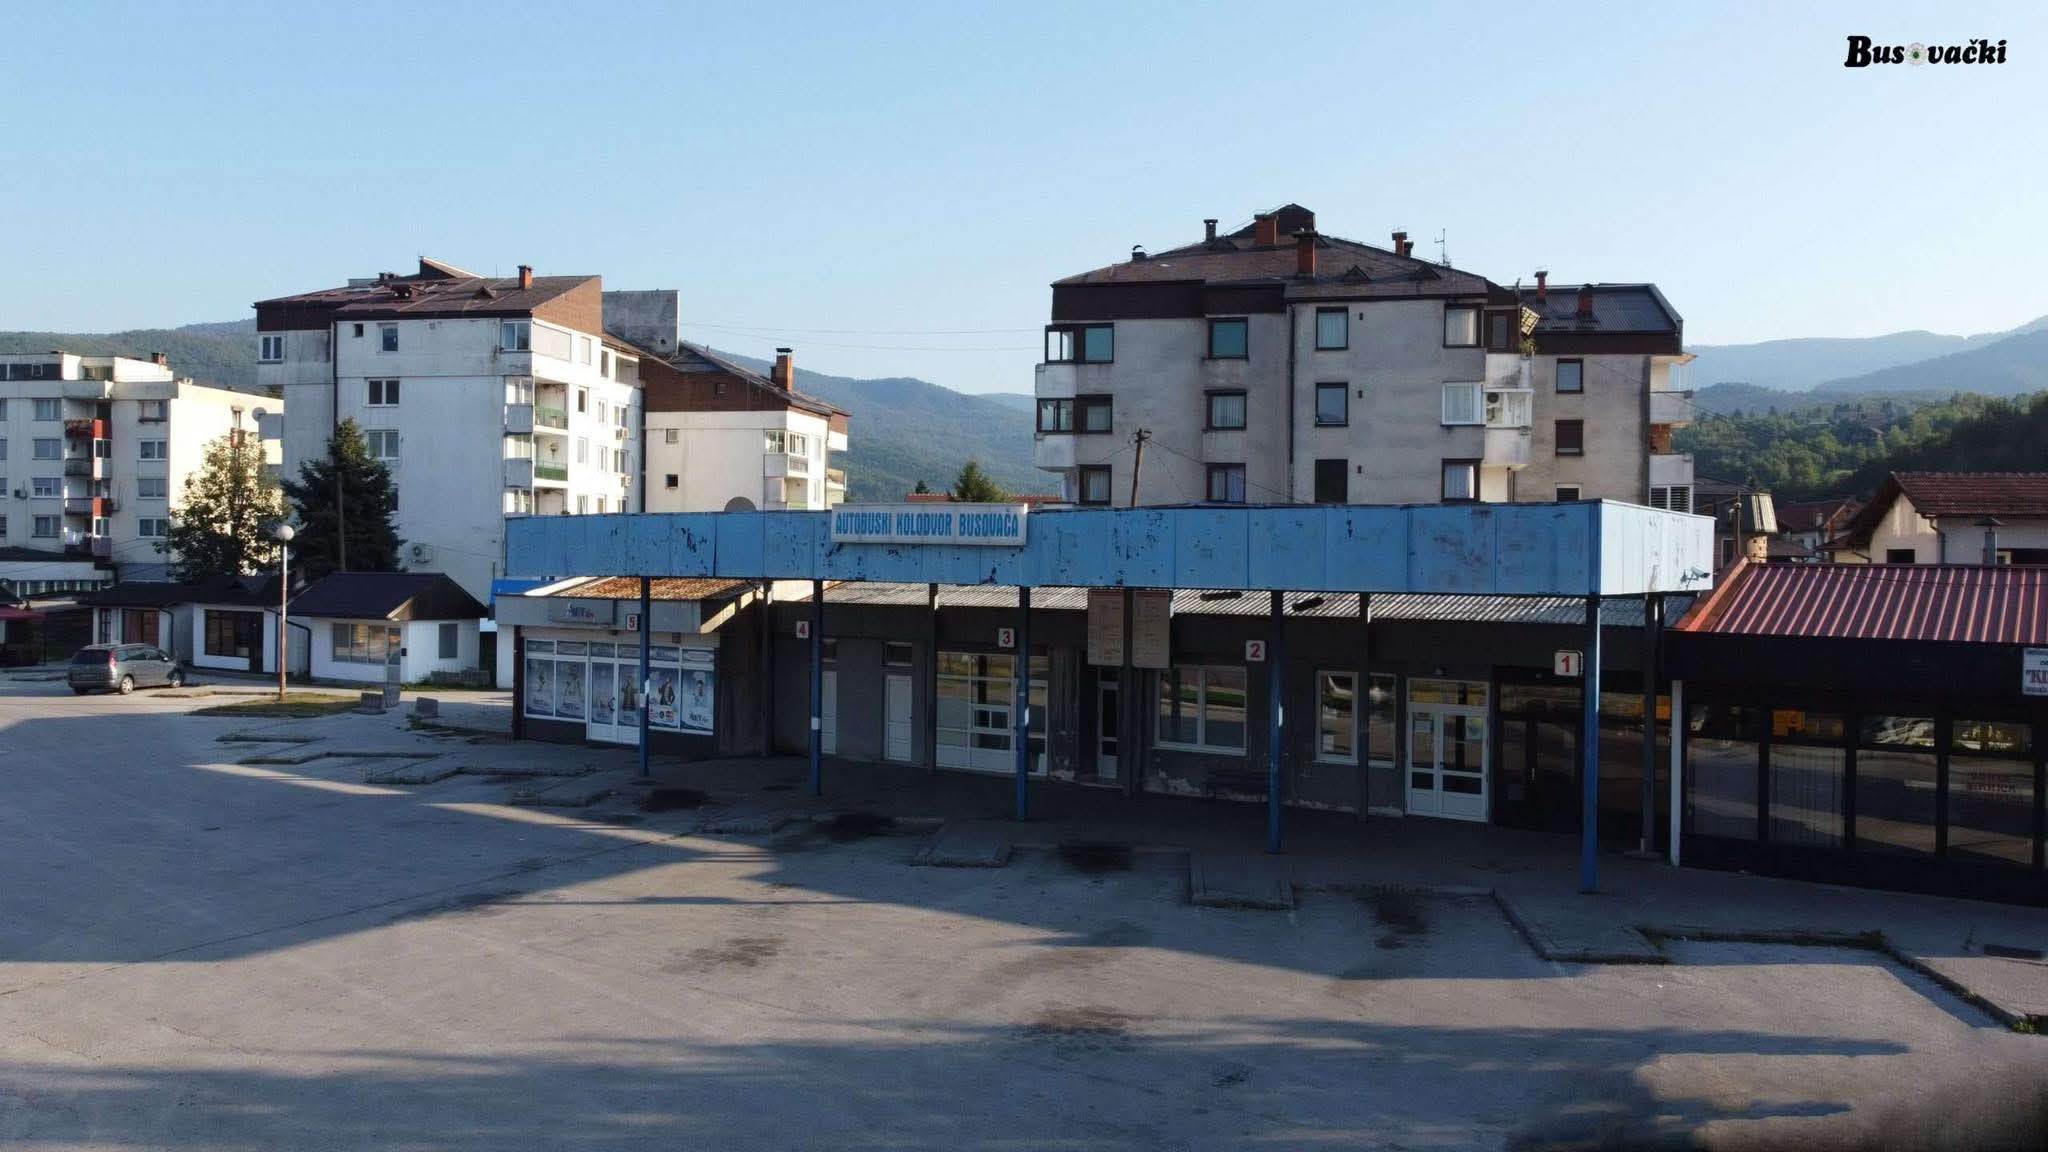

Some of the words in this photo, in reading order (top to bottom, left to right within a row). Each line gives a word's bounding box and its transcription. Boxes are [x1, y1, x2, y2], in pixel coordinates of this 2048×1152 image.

[835, 511, 892, 536] AUTOBUSKI
[896, 512, 952, 537] KOLODVOR
[959, 508, 1019, 537] BUSOVAČA
[629, 616, 636, 628] 5
[799, 623, 807, 636] 4
[1003, 630, 1011, 645] 3
[1250, 642, 1261, 658] 2
[1561, 655, 1570, 673] 1
